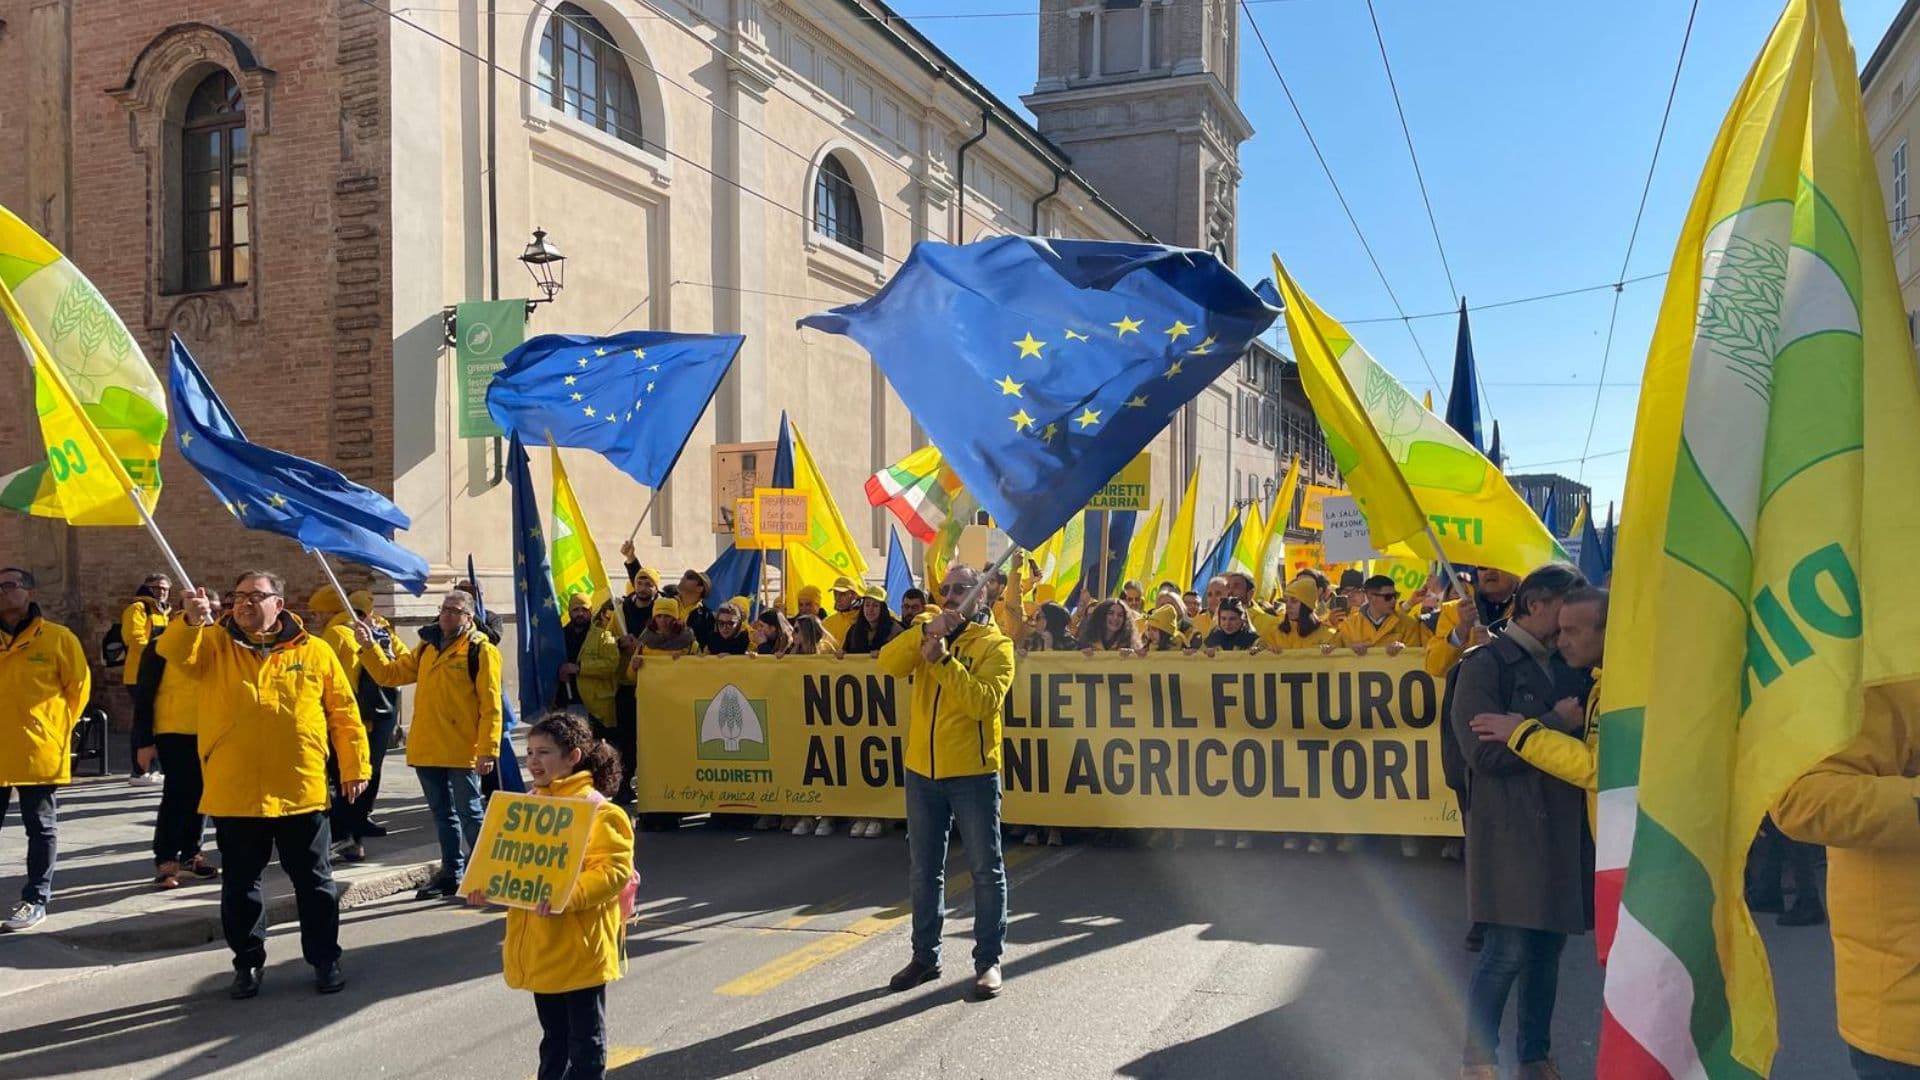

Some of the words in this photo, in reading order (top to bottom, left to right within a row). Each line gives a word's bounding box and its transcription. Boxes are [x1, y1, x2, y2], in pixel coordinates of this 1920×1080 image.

[1338, 510, 1360, 518] SALU
[803, 674, 897, 727] NON
[1150, 673, 1198, 728] IL
[1211, 670, 1437, 730] FUTURO
[695, 768, 773, 783] COLDIRETTI
[802, 735, 848, 787] AI
[1064, 738, 1430, 801] AGRICOLTORI
[663, 785, 676, 800] la
[681, 786, 716, 807] forza
[718, 790, 756, 801] amica
[760, 786, 780, 801] del
[785, 789, 823, 803] Paese
[503, 801, 574, 836] STOP
[490, 832, 569, 870] import
[485, 869, 553, 903] sleale
